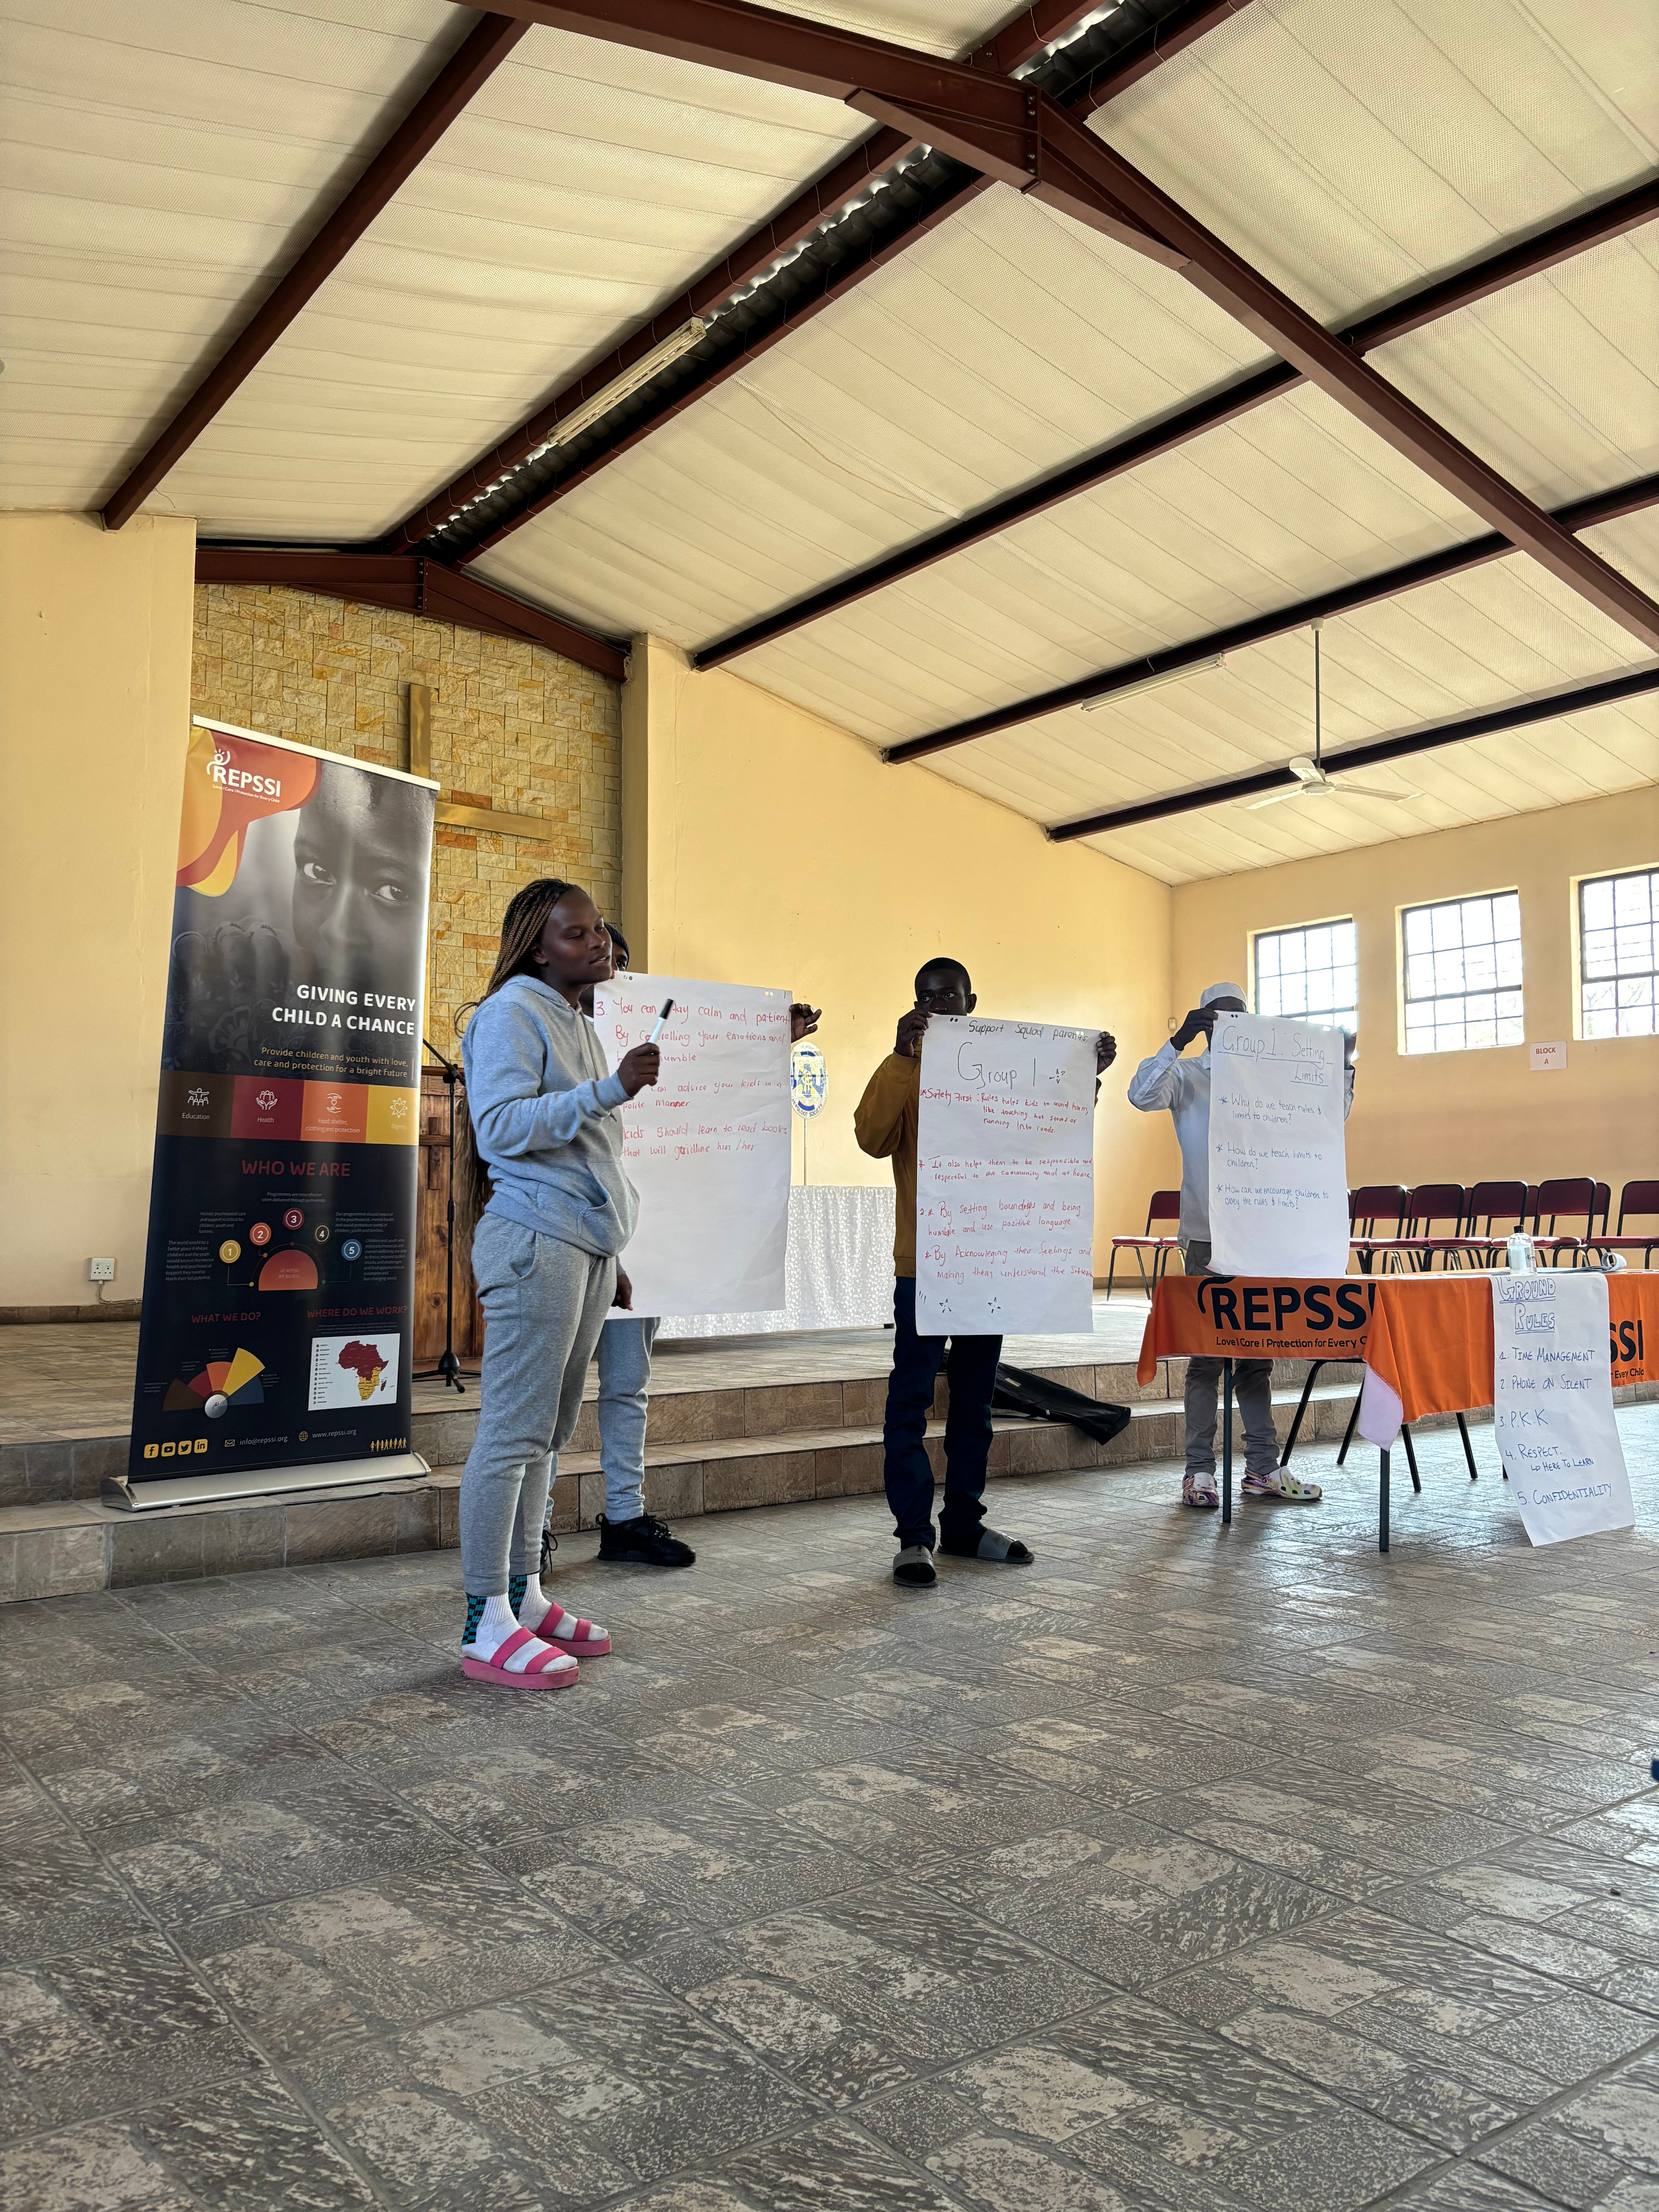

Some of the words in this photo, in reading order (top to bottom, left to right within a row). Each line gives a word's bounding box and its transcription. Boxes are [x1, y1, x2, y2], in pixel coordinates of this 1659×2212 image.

[213, 765, 281, 797] REPSSI
[297, 984, 358, 1005] GIVING
[364, 993, 416, 1011] EVERY
[596, 1001, 608, 1015] 3.
[613, 997, 633, 1015] You
[641, 1005, 656, 1014] can
[698, 1006, 721, 1019] calm
[730, 1008, 747, 1026] and
[756, 1012, 790, 1026] patient
[272, 1007, 327, 1026] CHILD
[331, 1014, 341, 1028] A
[347, 1016, 415, 1035] CHANCE
[616, 1025, 629, 1047] By
[699, 1030, 719, 1047] your
[726, 1032, 766, 1041] emotions
[769, 1034, 785, 1045] and
[969, 1020, 1005, 1036] Support
[1015, 1024, 1044, 1039] Squad
[1223, 1026, 1265, 1063] Group
[1291, 1032, 1324, 1070] Setting
[262, 1048, 293, 1057] Provide
[296, 1050, 328, 1060] children
[346, 1054, 369, 1063] youth
[392, 1058, 408, 1067] love,
[292, 1062, 334, 1072] protection
[357, 1066, 381, 1077] bright
[383, 1068, 407, 1078] future
[958, 1042, 1017, 1090] Group
[1295, 1063, 1324, 1084] Limits
[714, 1082, 733, 1094] your
[623, 1102, 645, 1113] polite
[981, 1093, 998, 1103] Rules
[1002, 1097, 1019, 1106] helps
[1231, 1092, 1250, 1114] Why
[1255, 1096, 1263, 1108] do
[1279, 1099, 1296, 1111] teach
[1298, 1104, 1315, 1113] rules
[984, 1105, 994, 1113] like
[1001, 1109, 1028, 1120] touching
[1233, 1111, 1250, 1120] limits
[1253, 1111, 1260, 1120] to
[1262, 1113, 1291, 1125] children?
[984, 1118, 1009, 1128] running
[650, 1146, 666, 1154] will
[1228, 1142, 1246, 1154] How
[1249, 1147, 1256, 1156] do
[1271, 1148, 1290, 1158] teach
[1293, 1149, 1311, 1159] limits
[1314, 1151, 1322, 1160] to
[242, 1160, 284, 1175] WHO
[290, 1161, 315, 1176] WE
[319, 1163, 350, 1176] ARE
[948, 1159, 960, 1168] also
[965, 1159, 982, 1168] helps
[1039, 1158, 1079, 1167] responsible
[1227, 1158, 1258, 1169] children?
[935, 1173, 967, 1183] respectful
[1044, 1168, 1057, 1176] and
[1225, 1183, 1240, 1193] How
[1264, 1187, 1293, 1200] encourage
[1295, 1189, 1320, 1199] children
[1323, 1190, 1328, 1199] to
[1043, 1200, 1055, 1211] and
[1062, 1201, 1081, 1217] being
[1243, 1196, 1252, 1205] the
[1254, 1197, 1267, 1206] rules
[1278, 1197, 1298, 1209] limits?
[291, 1215, 297, 1223] 3
[963, 1221, 976, 1233] and
[1002, 1219, 1031, 1230] positive
[1039, 1216, 1071, 1231] language
[228, 1248, 232, 1256] 1
[931, 1245, 946, 1266] By
[1015, 1246, 1032, 1254] their
[937, 1270, 964, 1285] making
[972, 1267, 993, 1278] them
[1001, 1267, 1046, 1277] understand
[1051, 1266, 1065, 1274] the
[1495, 1276, 1556, 1300] GROUND
[307, 1309, 340, 1318] WHERE
[343, 1308, 357, 1316] DO
[376, 1306, 407, 1315] WORK?
[1211, 1283, 1377, 1331] REPSSI
[192, 1314, 220, 1323] WHAT
[223, 1313, 240, 1322] WE
[242, 1312, 261, 1321] DO?
[1515, 1303, 1555, 1330] RULES
[1216, 1336, 1235, 1346] Love
[1240, 1338, 1260, 1348] Care
[1267, 1338, 1313, 1348] Protection
[1314, 1338, 1327, 1347] for
[1328, 1339, 1357, 1348] Every
[1610, 1320, 1644, 1364] SSI
[1511, 1347, 1532, 1360] TIME
[1537, 1347, 1595, 1362] MANAGEMENT
[1512, 1375, 1535, 1389] PHONE
[1542, 1377, 1554, 1389] ON
[1560, 1374, 1592, 1389] SILENT
[1614, 1370, 1628, 1379] Every
[240, 1435, 288, 1446] info@repssi.org
[312, 1429, 357, 1439] www.repssi.org
[1542, 1462, 1560, 1471] HERE
[1561, 1459, 1570, 1467] TO
[1572, 1458, 1594, 1467] LEARN
[1517, 1491, 1530, 1505] 5.
[1533, 1483, 1612, 1504] CONFIDENTIALITY
